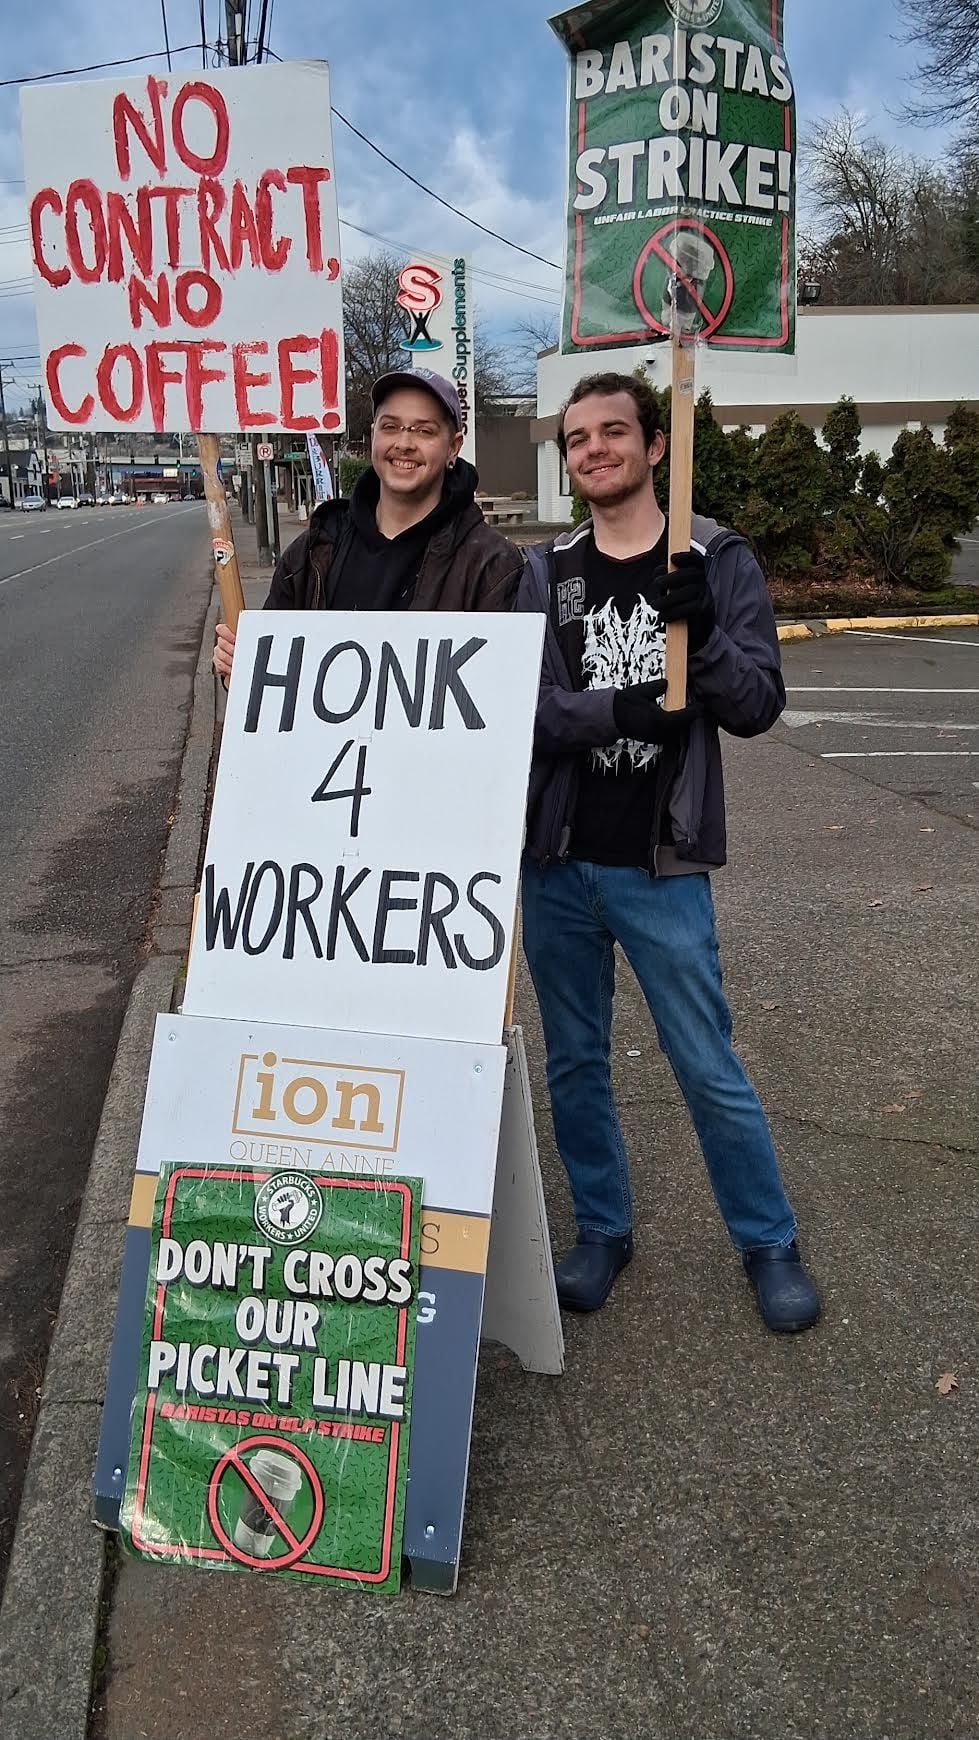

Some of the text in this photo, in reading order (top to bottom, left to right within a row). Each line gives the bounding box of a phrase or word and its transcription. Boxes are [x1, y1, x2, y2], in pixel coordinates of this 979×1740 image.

[575, 28, 793, 101] BARISTAS
[112, 74, 230, 181] NO
[658, 86, 718, 136] ON
[573, 136, 792, 212] STRIKE!
[30, 165, 340, 288] CONTRACT,
[593, 206, 773, 227] UNFAIR LABOR PRACTICE STRIKE
[128, 270, 223, 329] NO
[46, 328, 340, 432] COFFEE!
[243, 635, 487, 733] HONK
[311, 739, 372, 838] 4
[205, 860, 506, 971] WORKERS
[252, 1051, 385, 1134] ion
[229, 1140, 395, 1175] QUEEN ANNE
[266, 1176, 316, 1198] STARBUCKS
[258, 1205, 318, 1240] WORKERS UNITED
[156, 1237, 412, 1304] DON'T CROSS
[235, 1296, 320, 1347] OUR
[148, 1340, 407, 1416] PICKET LINE
[159, 1402, 385, 1444] BARISTAS ON ULP STRIKE
